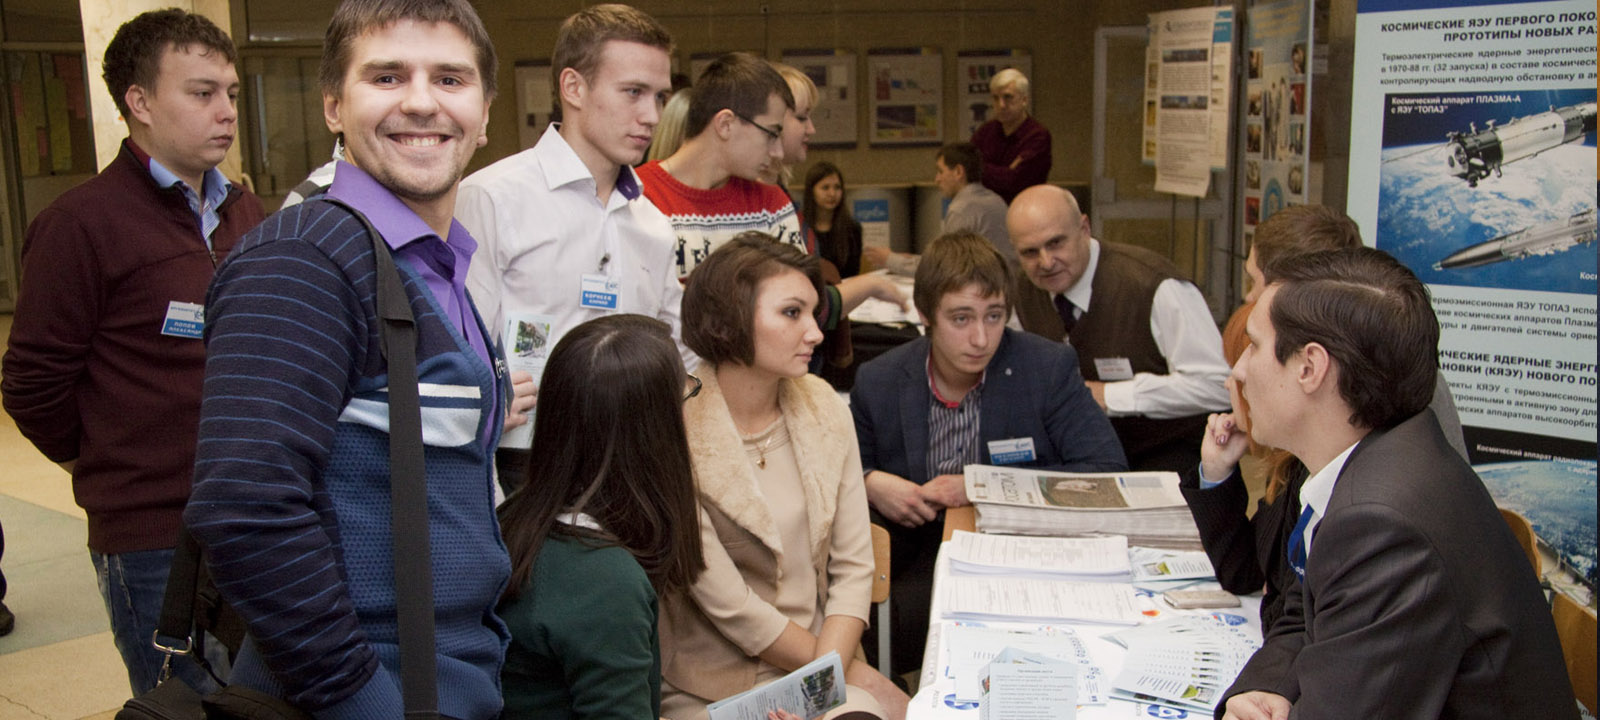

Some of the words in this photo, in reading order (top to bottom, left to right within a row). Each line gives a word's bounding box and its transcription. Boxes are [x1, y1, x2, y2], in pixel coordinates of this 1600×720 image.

[1381, 20, 1465, 32] КОСМИЧЕСКИЕ
[1468, 17, 1492, 28] ЯЭУ
[1495, 14, 1555, 26] ПЕРВОГО
[1559, 11, 1597, 23] ПОКО
[1443, 29, 1521, 42] ПРОТОТИПЫ
[1525, 26, 1574, 38] НОВЫХ
[1382, 51, 1474, 61] Термоэлектрические
[1478, 49, 1522, 58] ядерные
[1389, 64, 1420, 73] 1970-88
[1449, 62, 1489, 72] запуска)
[1500, 61, 1540, 69] составе
[1380, 76, 1456, 86] контролирующих
[1458, 75, 1513, 84] надводную
[1516, 73, 1575, 82] обстановку
[1391, 96, 1441, 105] Космический
[1442, 97, 1474, 106] аппарат
[1475, 95, 1521, 104] ПЛАЗМА-А
[1397, 105, 1413, 114] ЯЭУ
[1432, 297, 1514, 308] ермоэмиссионная
[1516, 301, 1536, 310] ЯЭУ
[1538, 302, 1570, 313] ТОПАЗ
[1453, 311, 1511, 320] космических
[1513, 315, 1562, 325] аппаратов
[1470, 323, 1523, 333] двигателей
[1526, 328, 1567, 337] системы
[1440, 350, 1490, 362] ИЧЕСКИЕ
[1493, 354, 1552, 369] ЯДЕРНЫЕ
[1440, 362, 1481, 374] НОВКИ
[1485, 366, 1523, 379] (КЯЭУ)
[1526, 371, 1576, 384] НОВОГО
[1476, 383, 1501, 392] КЯЭУ
[1454, 394, 1504, 404] троенными
[1514, 400, 1557, 411] активную
[1559, 405, 1580, 415] зону
[1486, 408, 1533, 420] аппаратов
[1476, 443, 1523, 456] Космический
[1523, 450, 1552, 461] аппарат
